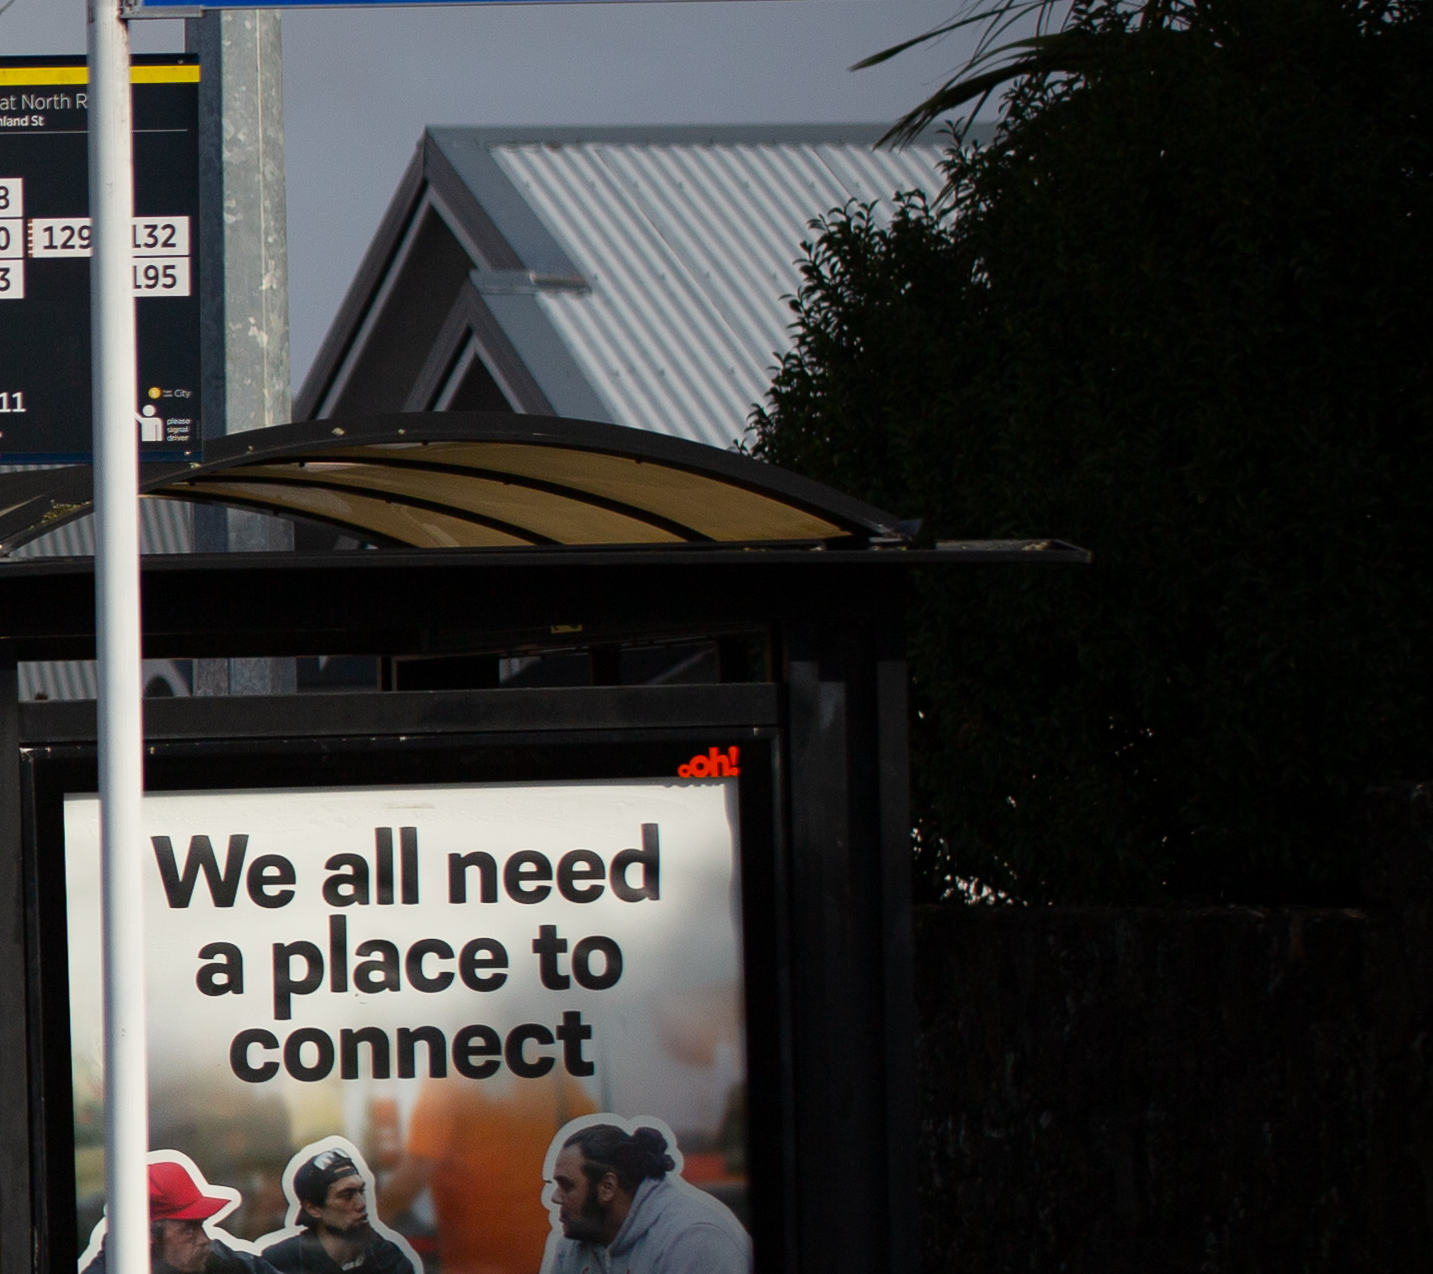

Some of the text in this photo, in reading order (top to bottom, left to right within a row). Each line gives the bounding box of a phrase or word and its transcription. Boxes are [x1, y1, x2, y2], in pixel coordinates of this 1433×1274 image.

[22, 93, 71, 110] North
[76, 93, 88, 109] R
[31, 115, 45, 126] St
[42, 225, 93, 251] 129
[174, 389, 192, 399] City
[167, 418, 191, 426] please
[167, 426, 189, 434] signal
[150, 822, 661, 909] We all need
[195, 913, 624, 1021] a place to
[229, 1010, 595, 1084] connect
